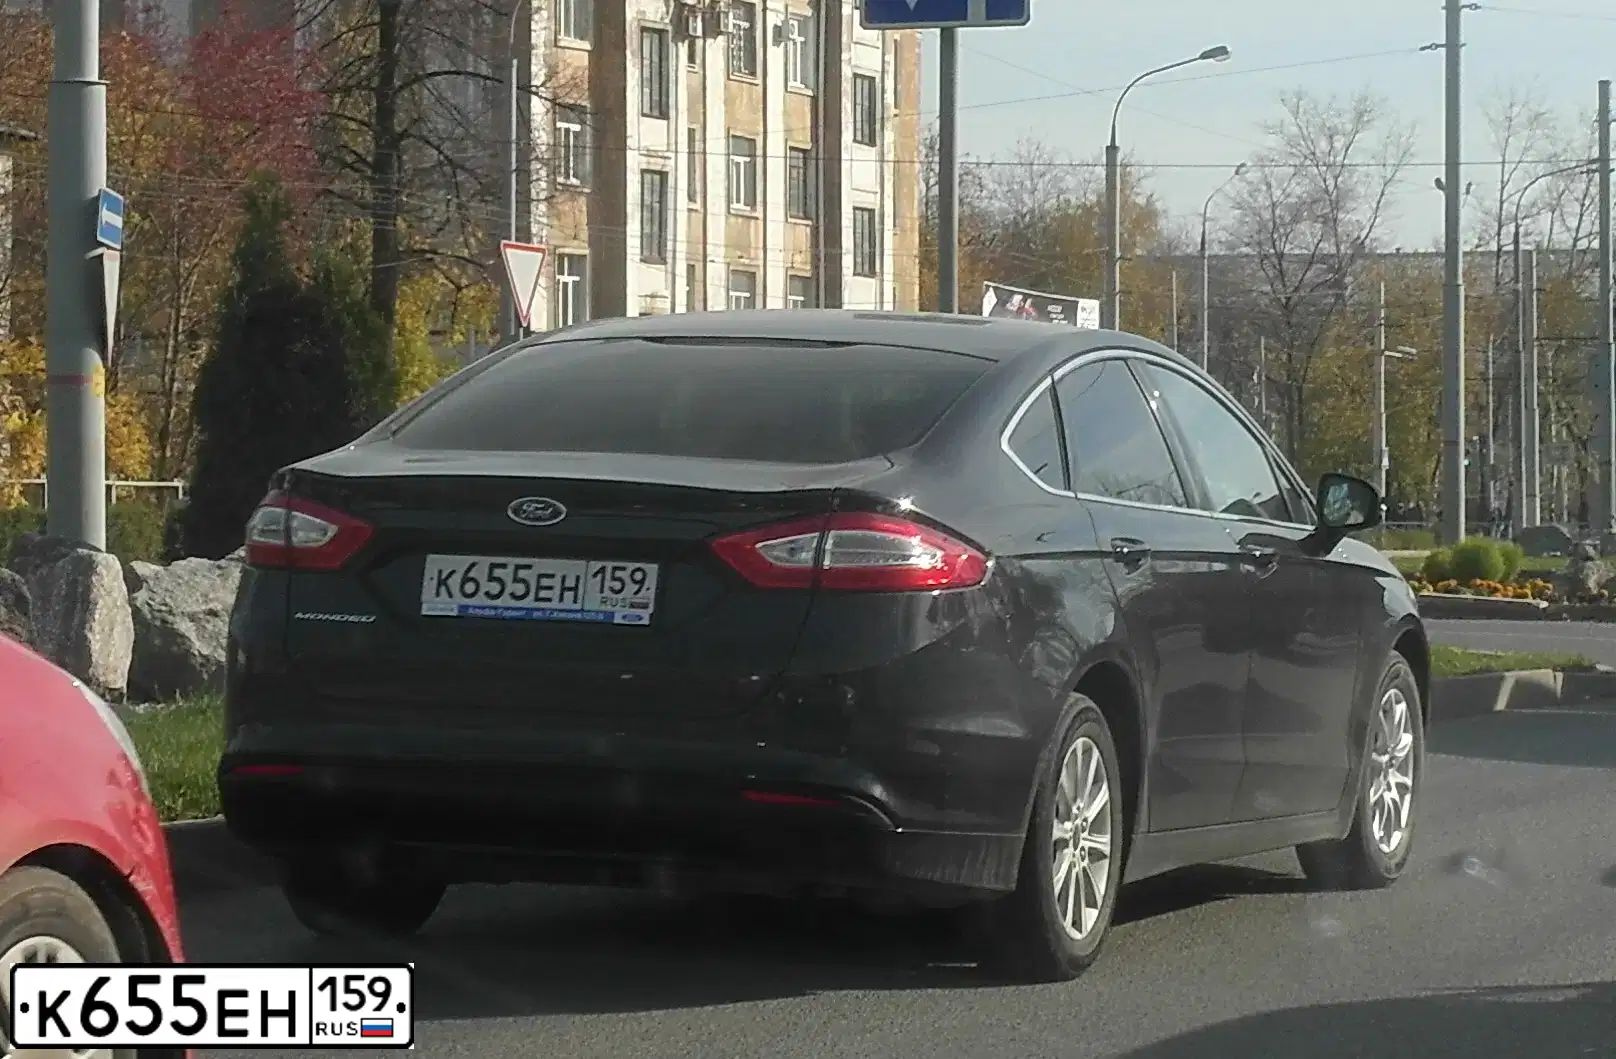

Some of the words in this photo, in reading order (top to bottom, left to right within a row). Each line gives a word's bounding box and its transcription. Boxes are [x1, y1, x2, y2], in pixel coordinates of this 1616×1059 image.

[591, 565, 648, 596] 159
[599, 596, 627, 609] RUS
[295, 612, 377, 622] MONDEO
